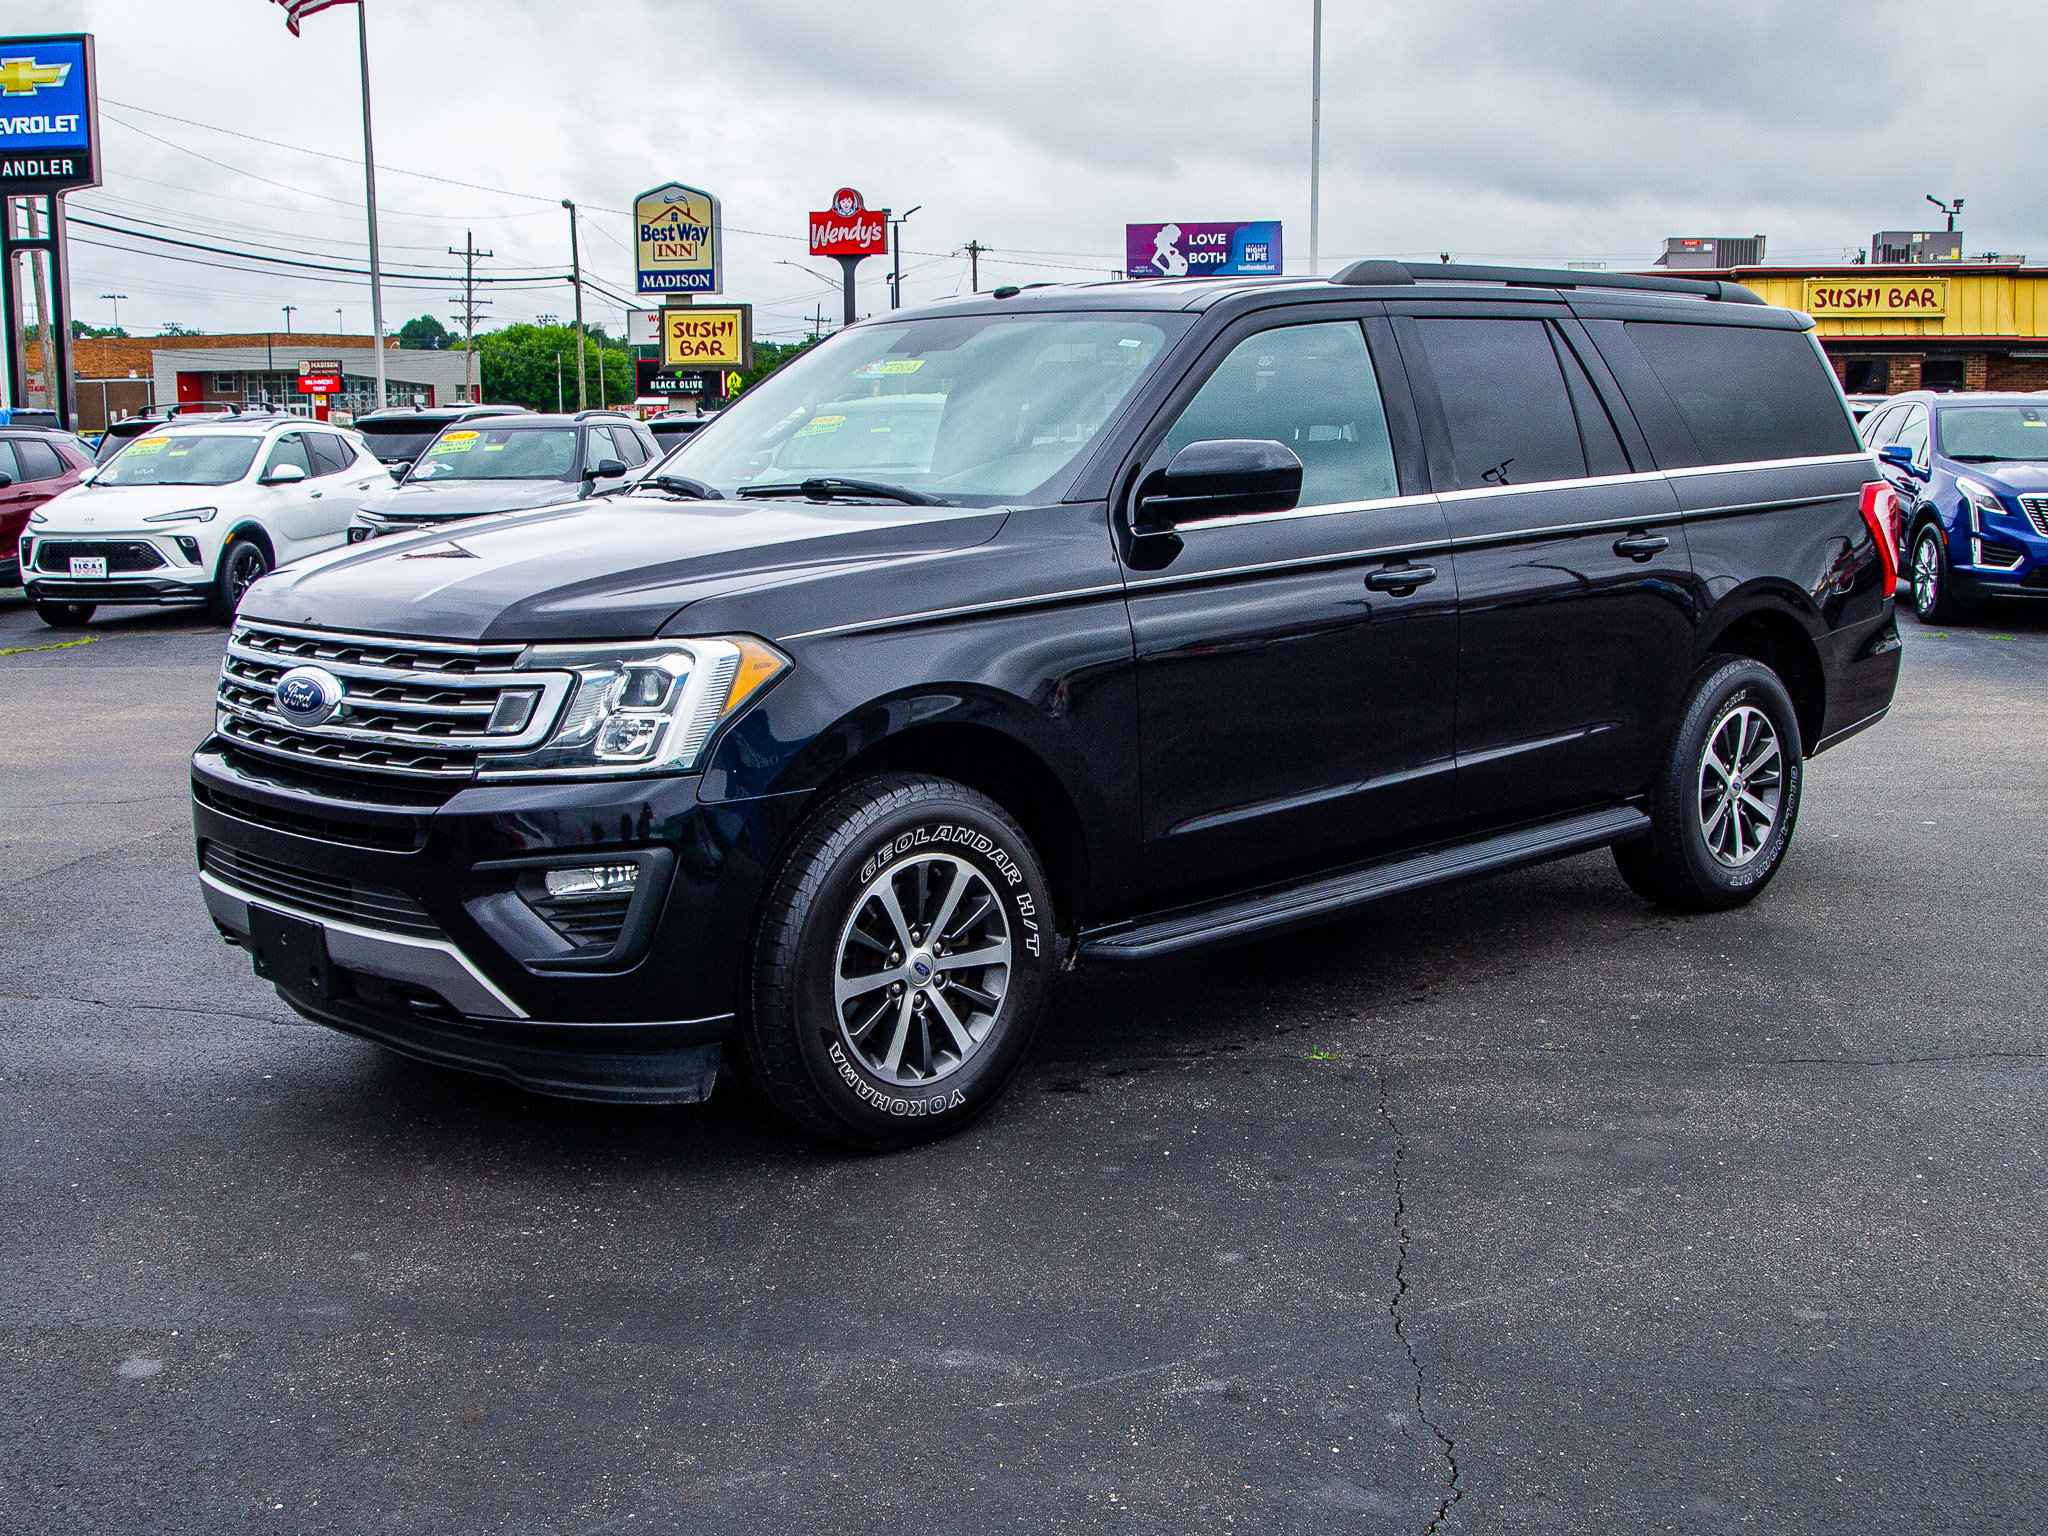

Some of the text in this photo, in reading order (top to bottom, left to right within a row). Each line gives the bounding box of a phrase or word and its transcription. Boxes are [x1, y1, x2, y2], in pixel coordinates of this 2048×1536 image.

[2, 159, 73, 177] ANDLER
[641, 223, 709, 246] Best Way
[812, 217, 882, 249] Wendy's
[1189, 233, 1227, 246] LOVE
[657, 243, 693, 257] INN
[1189, 252, 1227, 264] BOTH
[1245, 253, 1267, 261] LIFE
[642, 274, 710, 288] MADISON
[1814, 288, 1938, 308] SUSHI BAR
[672, 321, 733, 338] SUSHI
[680, 340, 726, 356] BAR
[650, 380, 703, 389] BLACK OLIVE
[283, 681, 315, 708] Ford
[860, 825, 1040, 956] GEOLANDAR H/T
[829, 1042, 965, 1117] YOKOHAMA
